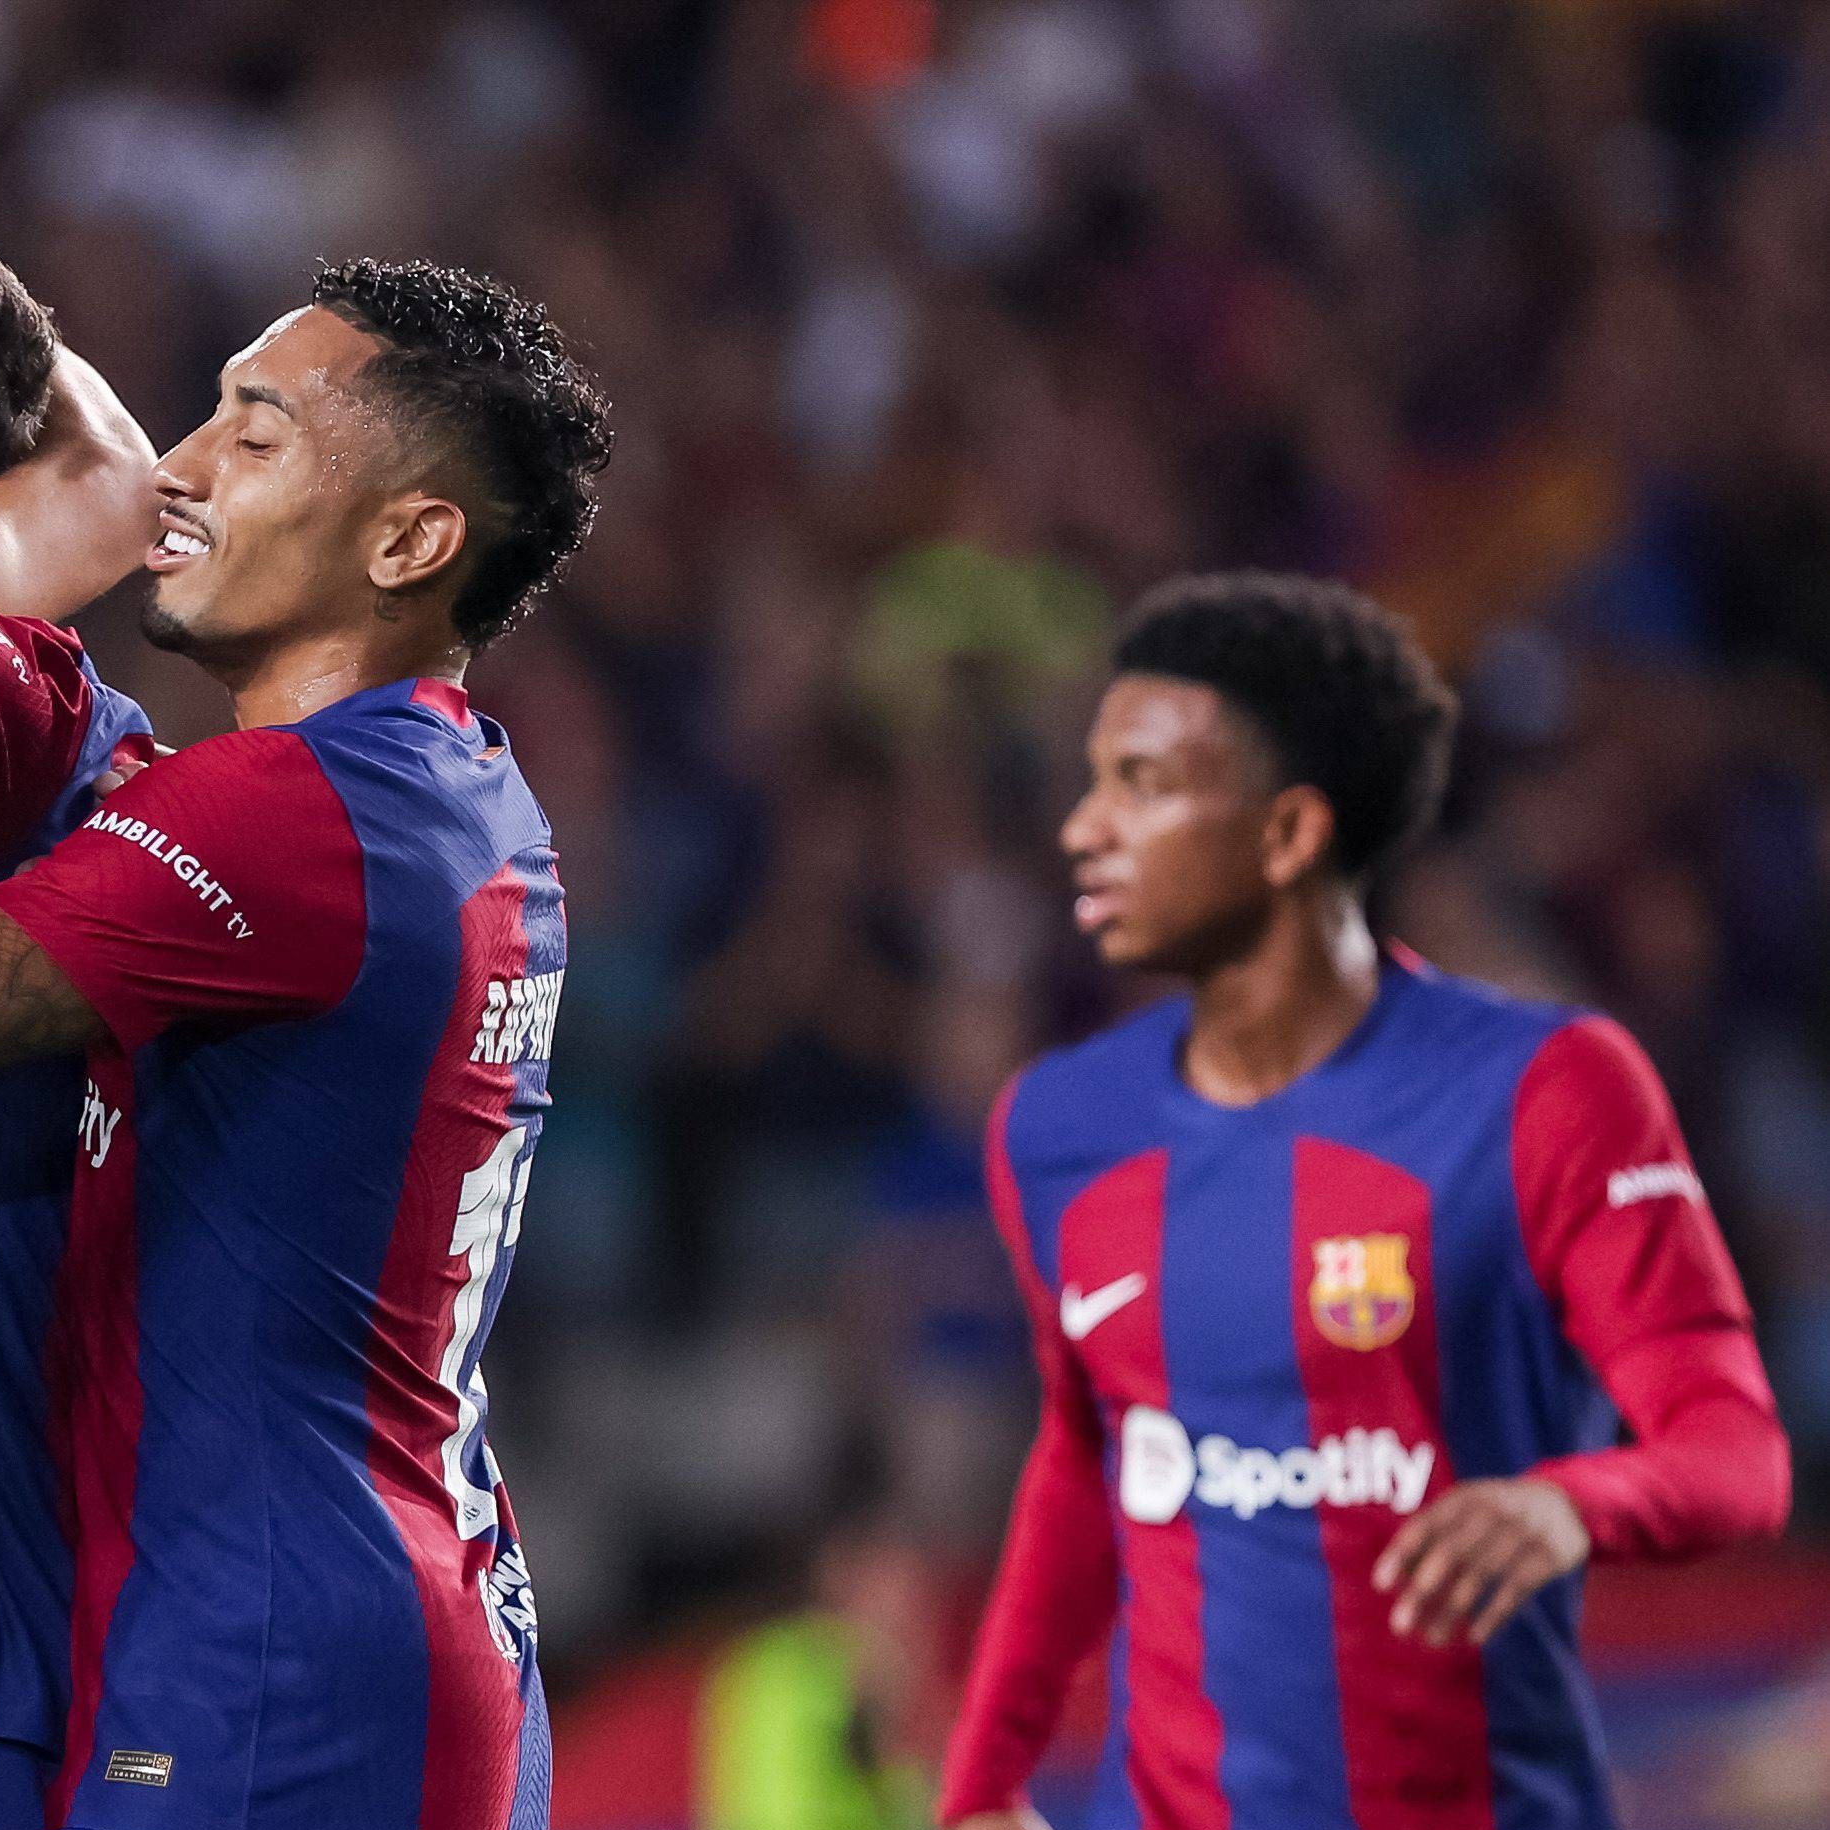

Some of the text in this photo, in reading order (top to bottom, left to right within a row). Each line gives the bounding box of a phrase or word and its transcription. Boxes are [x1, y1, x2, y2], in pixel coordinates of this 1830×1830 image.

[83, 809, 253, 939] AMBILIGHT tv
[1195, 1426, 1436, 1520] Spotify
